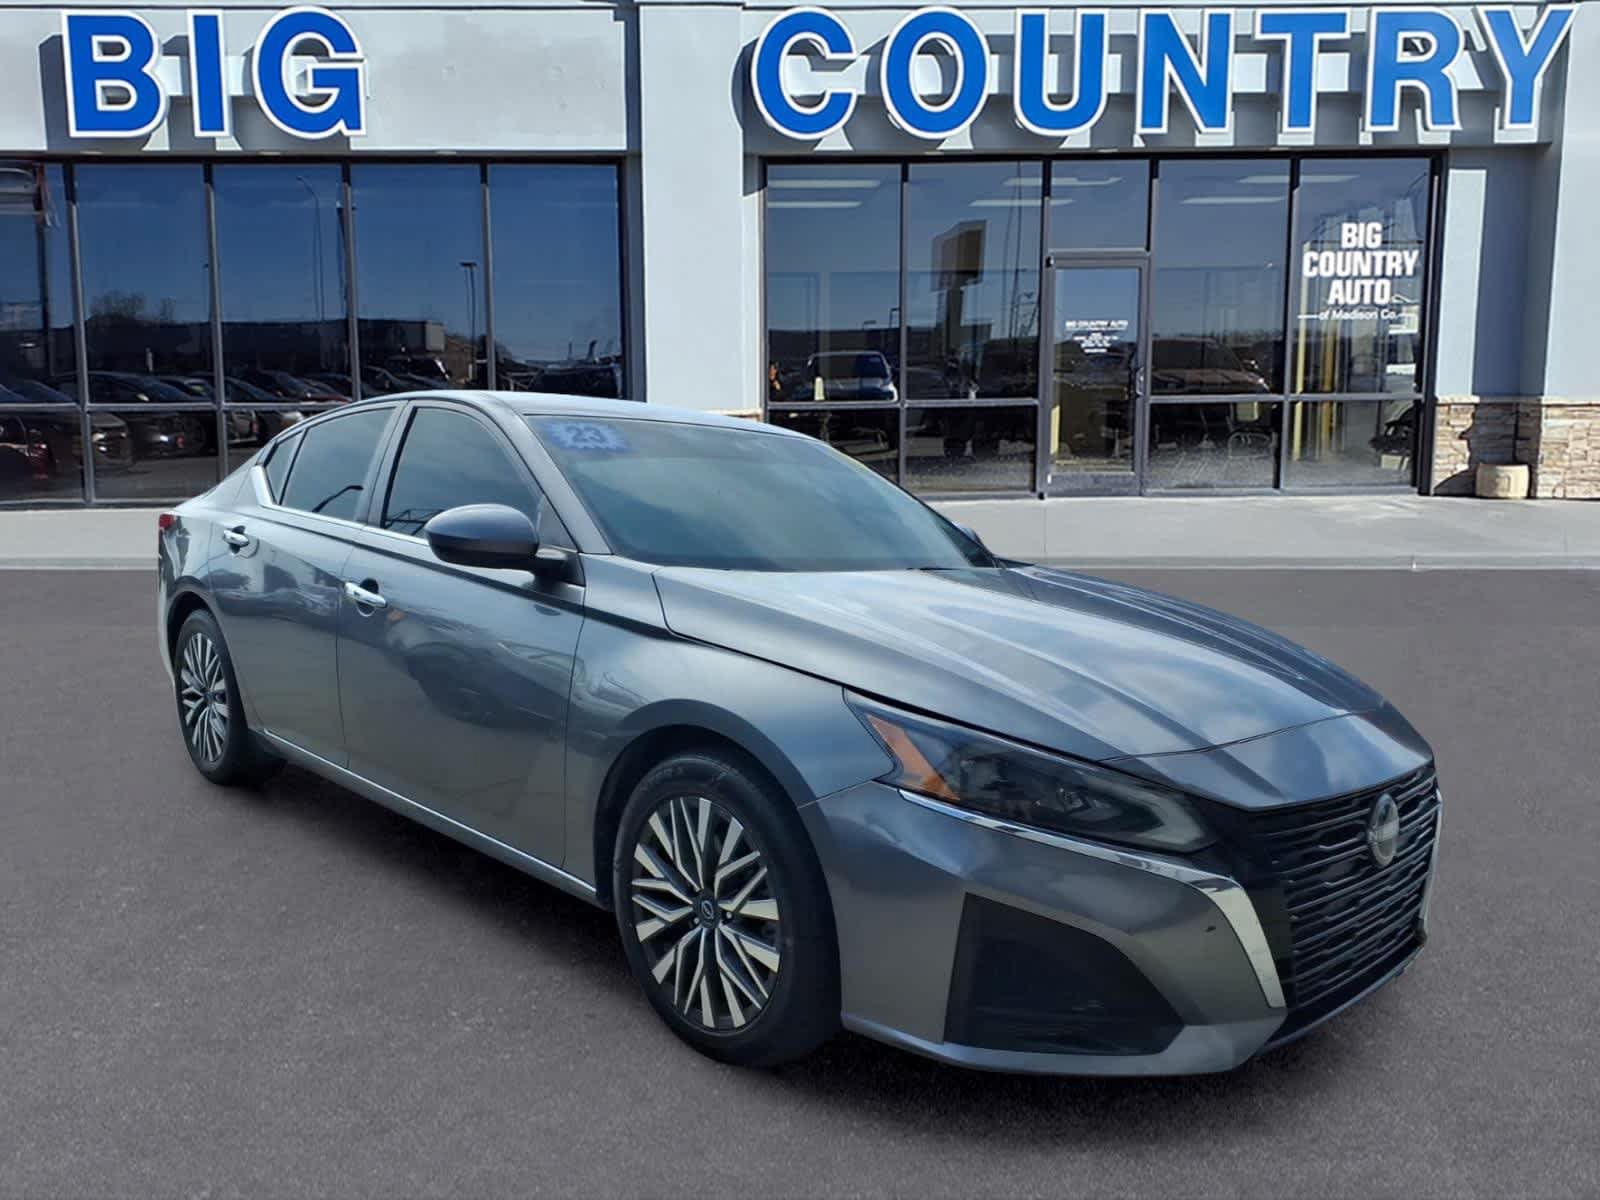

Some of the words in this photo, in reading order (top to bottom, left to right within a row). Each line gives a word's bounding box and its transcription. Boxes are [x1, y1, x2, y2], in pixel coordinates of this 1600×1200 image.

[61, 6, 366, 139] BIG
[751, 4, 1576, 140] COUNTRY
[1341, 222, 1382, 248] BIG
[1302, 250, 1419, 277] COUNTRY
[1328, 279, 1391, 305] AUTO
[1320, 309, 1330, 320] of
[1332, 309, 1377, 320] Madison
